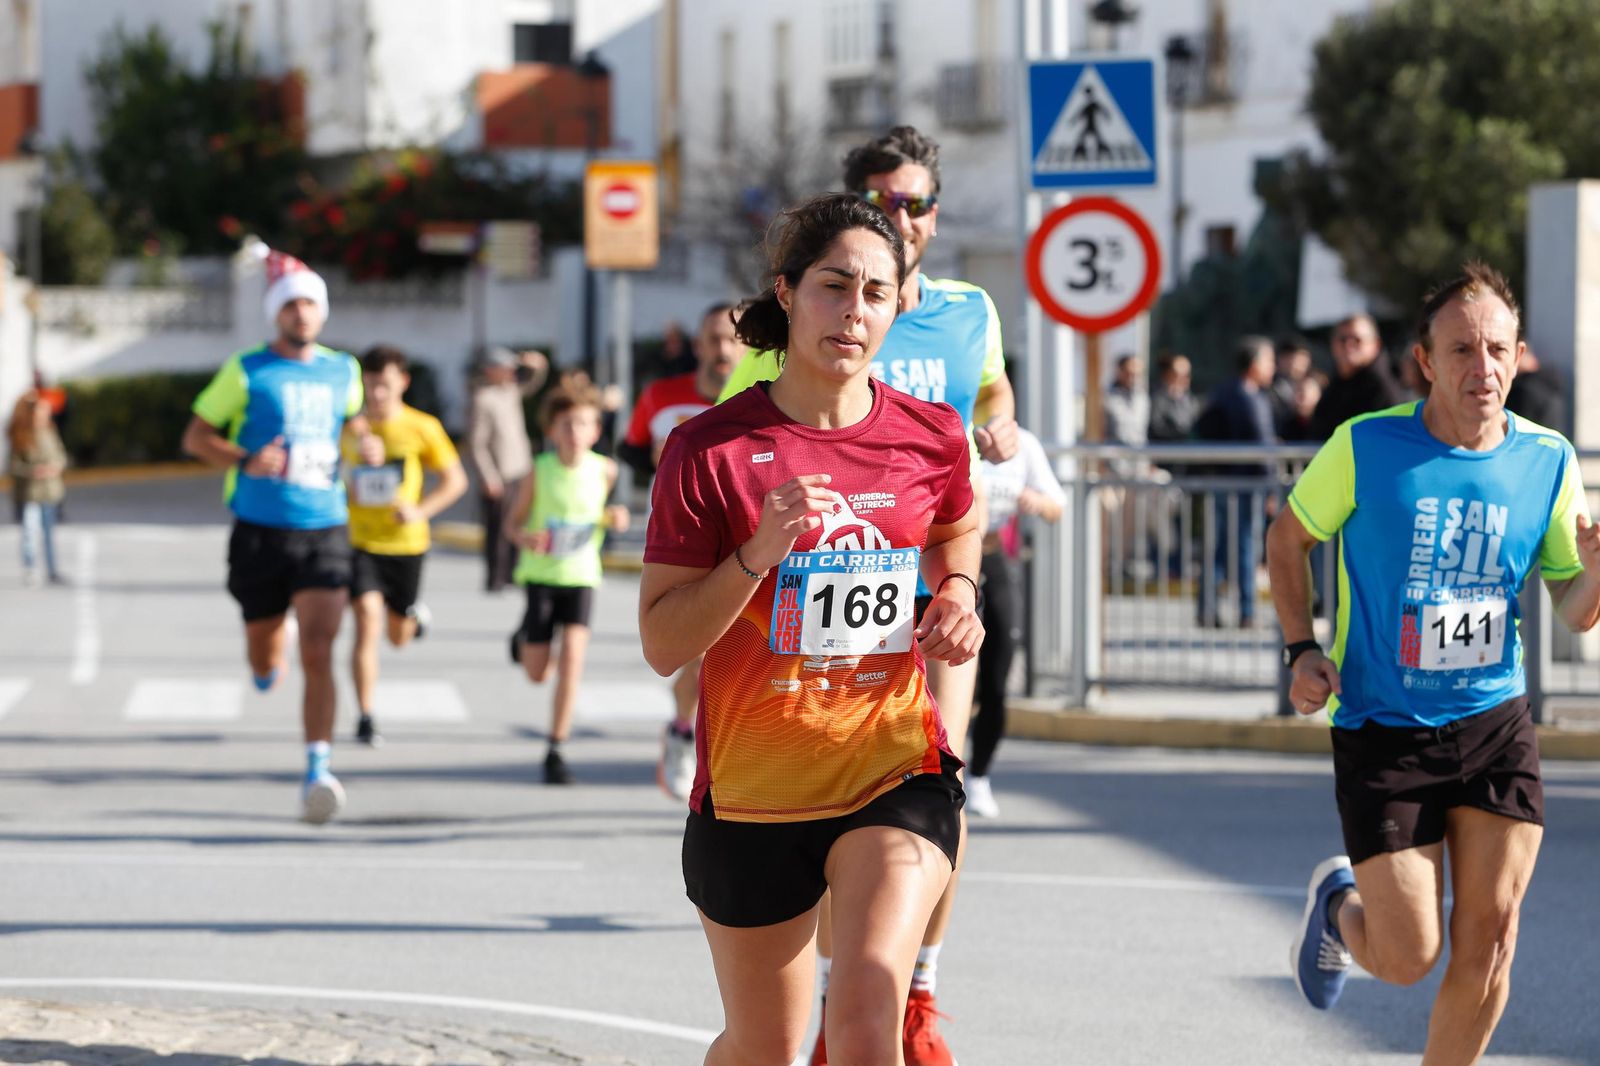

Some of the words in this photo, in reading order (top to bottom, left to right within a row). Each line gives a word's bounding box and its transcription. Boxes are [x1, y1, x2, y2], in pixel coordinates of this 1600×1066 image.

[1066, 237, 1099, 293] 3
[890, 358, 946, 387] SAN
[848, 492, 887, 502] CARRERA
[853, 500, 895, 510] ESTRECHO
[1444, 497, 1508, 537] SAN
[1407, 497, 1439, 589] ARRERA
[1437, 528, 1505, 577] SIL
[788, 555, 811, 568] III
[819, 551, 916, 567] CARRERA
[844, 564, 884, 574] TARIFA
[780, 574, 803, 589] SAN
[778, 588, 799, 609] SIL
[1430, 586, 1506, 601] CARRERA
[812, 582, 899, 629] 168
[776, 610, 803, 631] VES
[1431, 611, 1491, 649] 141
[774, 630, 800, 653] TRE
